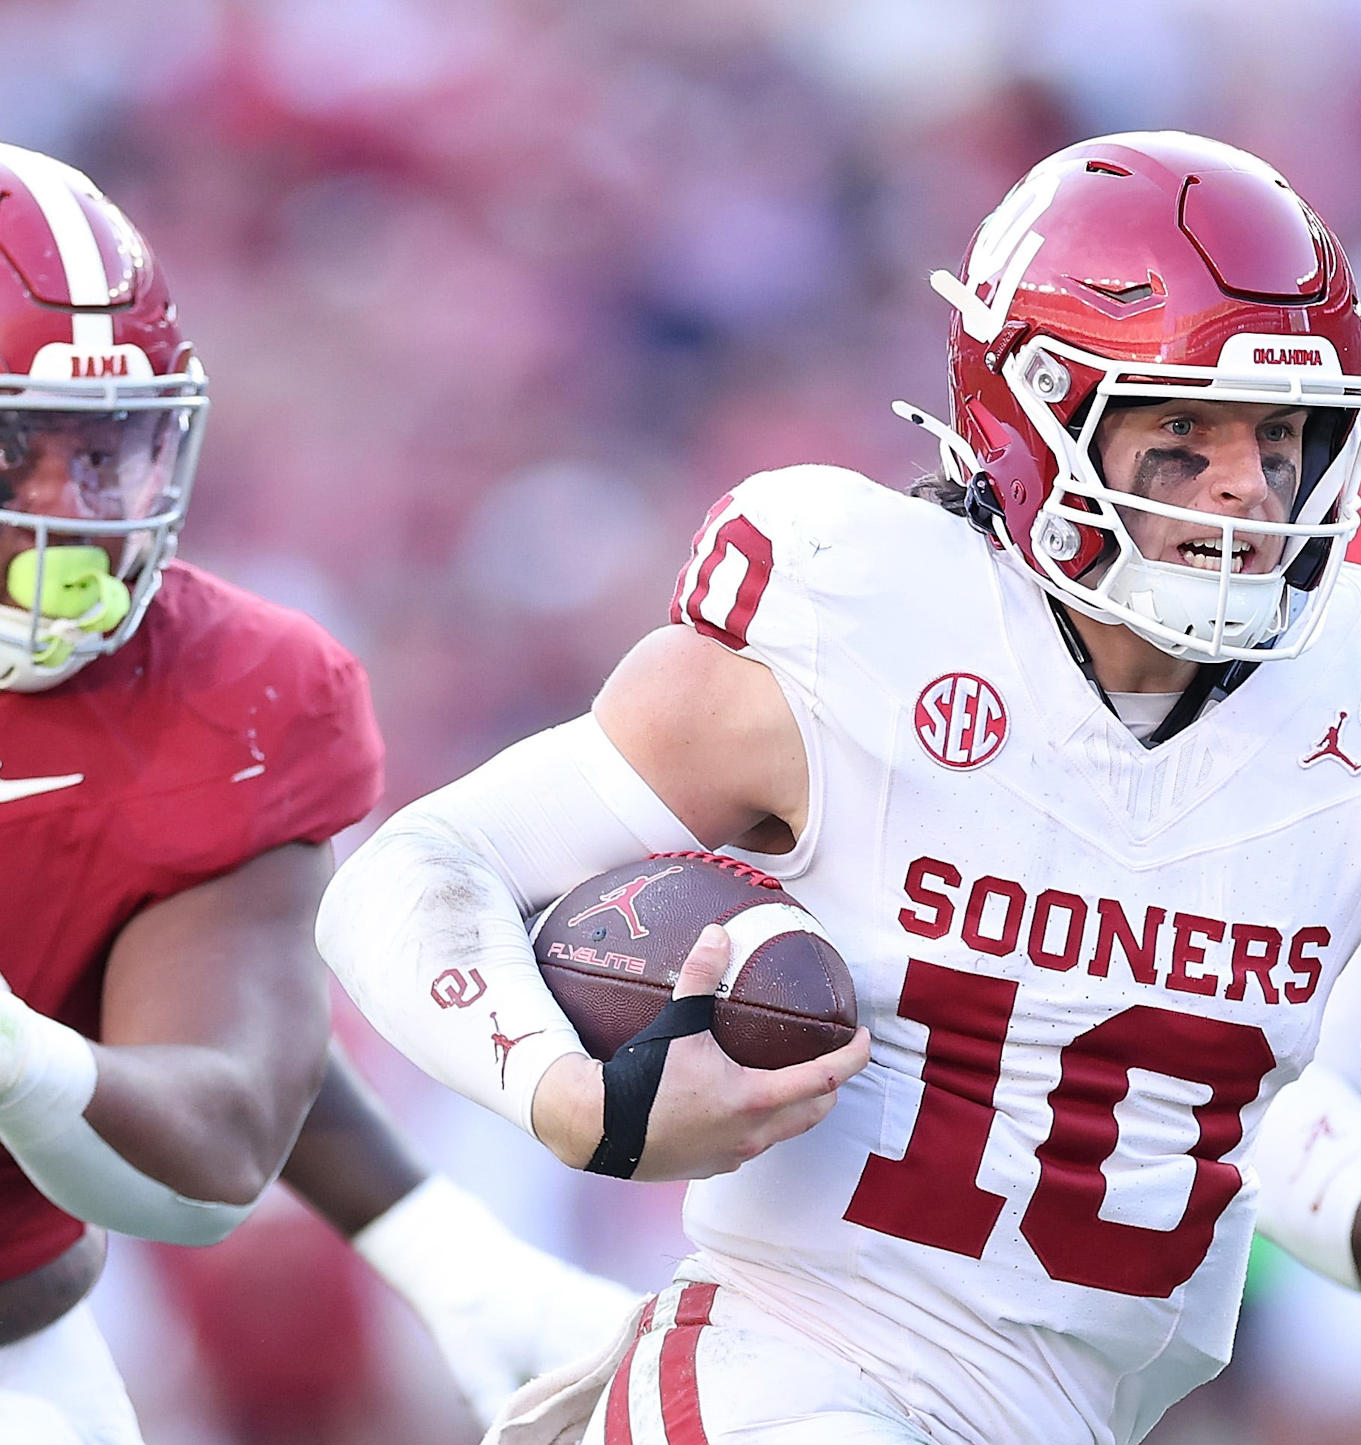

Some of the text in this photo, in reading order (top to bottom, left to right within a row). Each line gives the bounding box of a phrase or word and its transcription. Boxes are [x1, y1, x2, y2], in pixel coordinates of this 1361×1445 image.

[71, 354, 128, 377] BAMA
[1253, 348, 1323, 366] OKLAHOMA
[669, 493, 774, 651] 10
[915, 674, 1008, 769] SEC
[897, 856, 1332, 1005] SOONERS
[843, 957, 1277, 1299] 10
